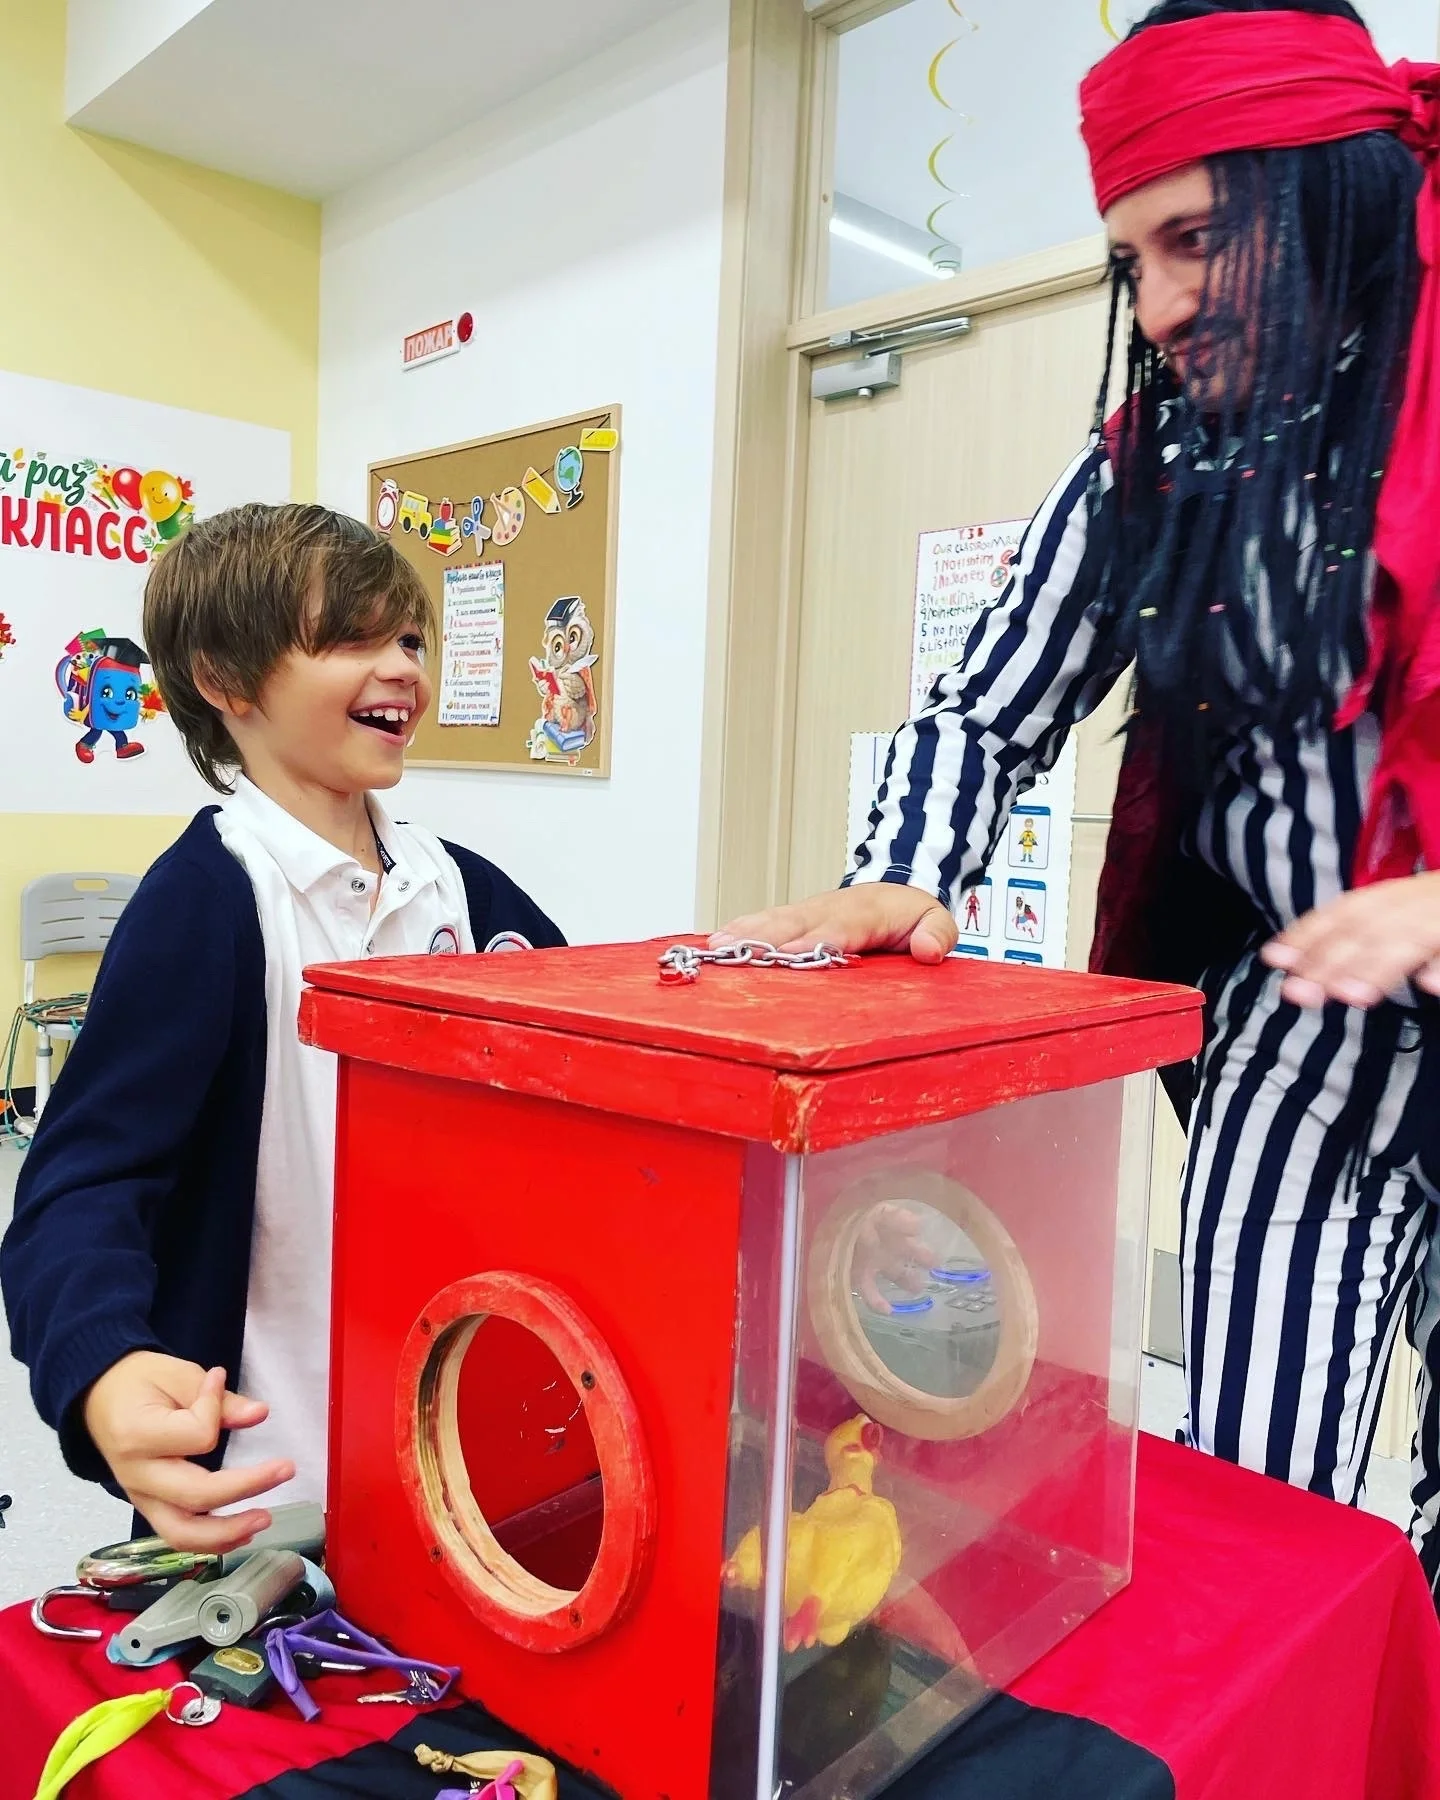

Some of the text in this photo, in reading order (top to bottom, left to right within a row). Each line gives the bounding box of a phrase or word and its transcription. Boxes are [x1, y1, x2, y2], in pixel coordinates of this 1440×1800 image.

[406, 325, 452, 361] ПОЖАР
[24, 459, 88, 506] раз
[1, 495, 148, 564] КЛАСС
